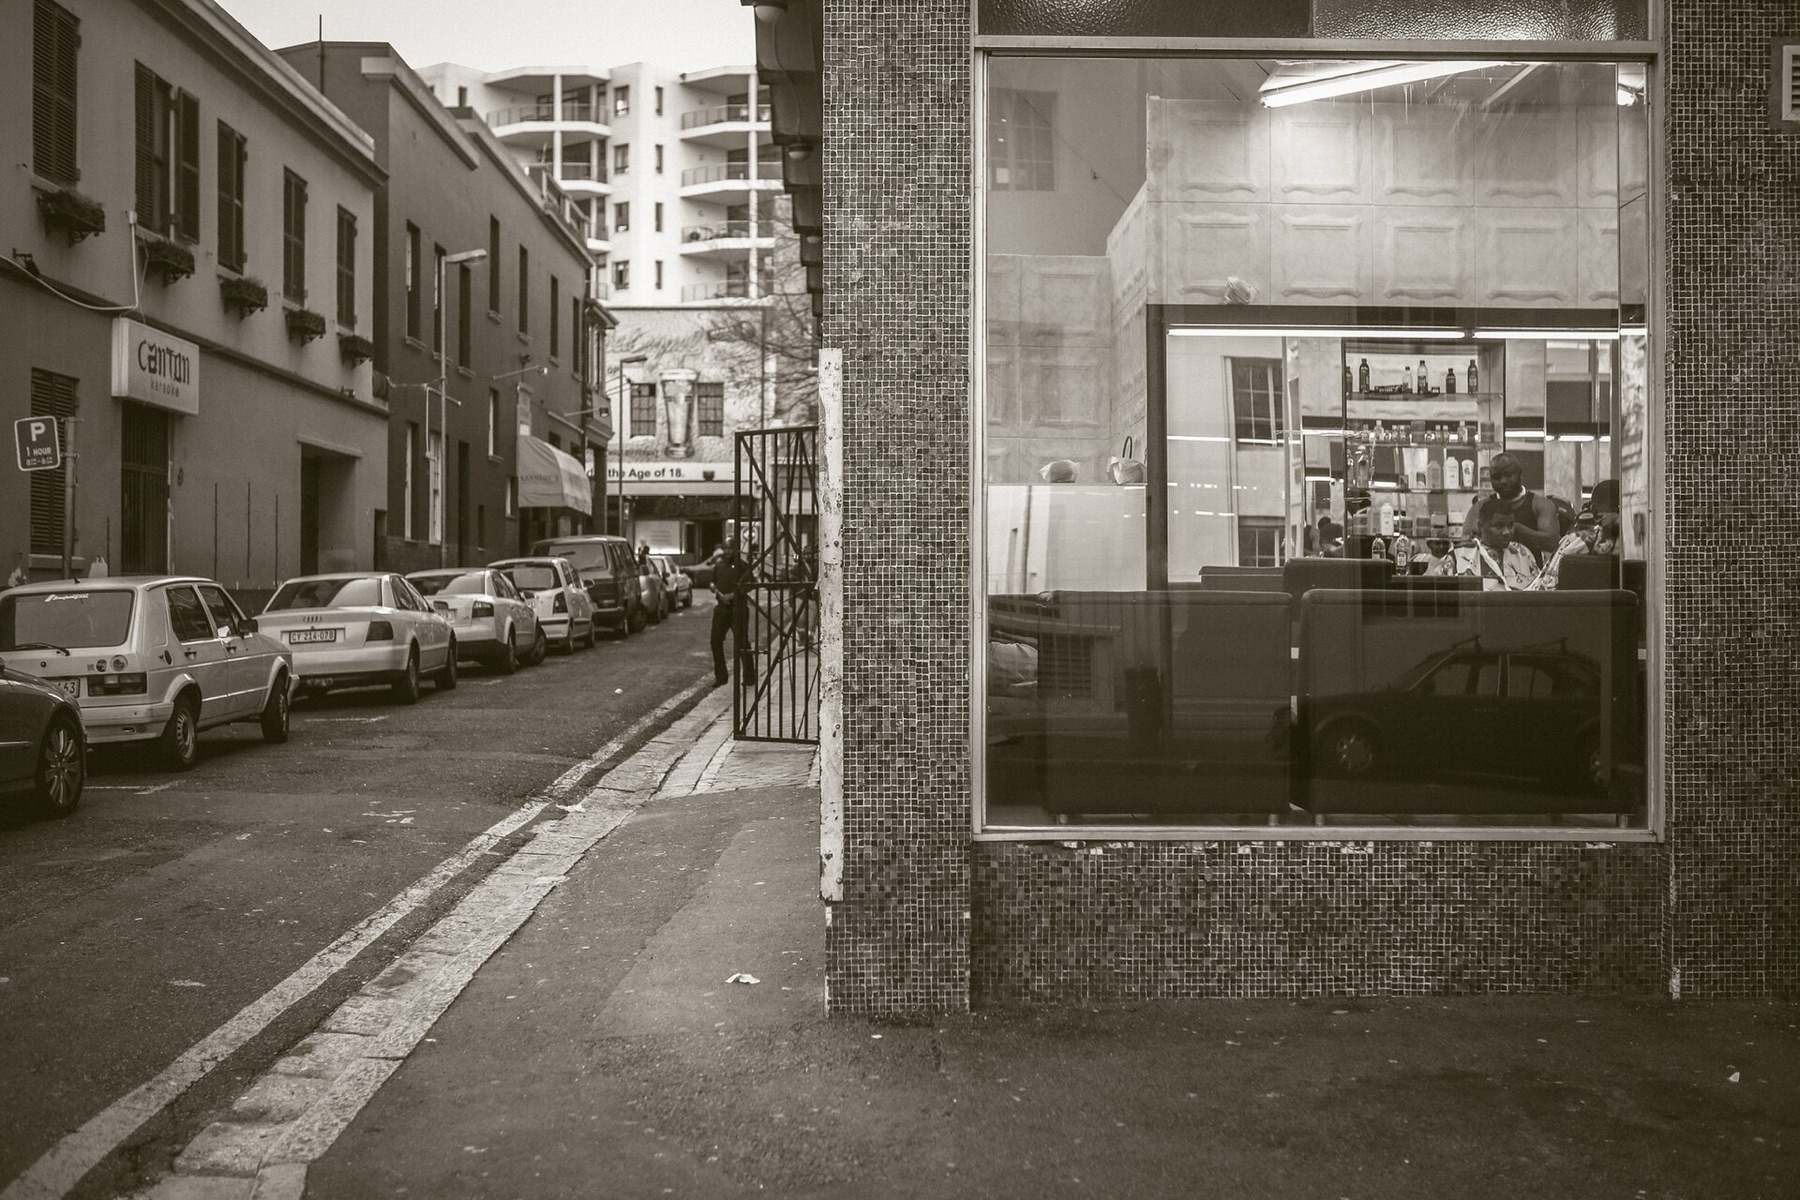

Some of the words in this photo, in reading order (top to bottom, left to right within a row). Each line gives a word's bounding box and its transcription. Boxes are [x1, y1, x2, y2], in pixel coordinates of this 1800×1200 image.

[151, 377, 179, 398] karaoke
[30, 422, 46, 441] P
[26, 446, 30, 457] 1
[32, 446, 52, 457] HOUR
[628, 467, 651, 480] Age
[654, 466, 666, 478] of
[669, 467, 685, 478] 18.
